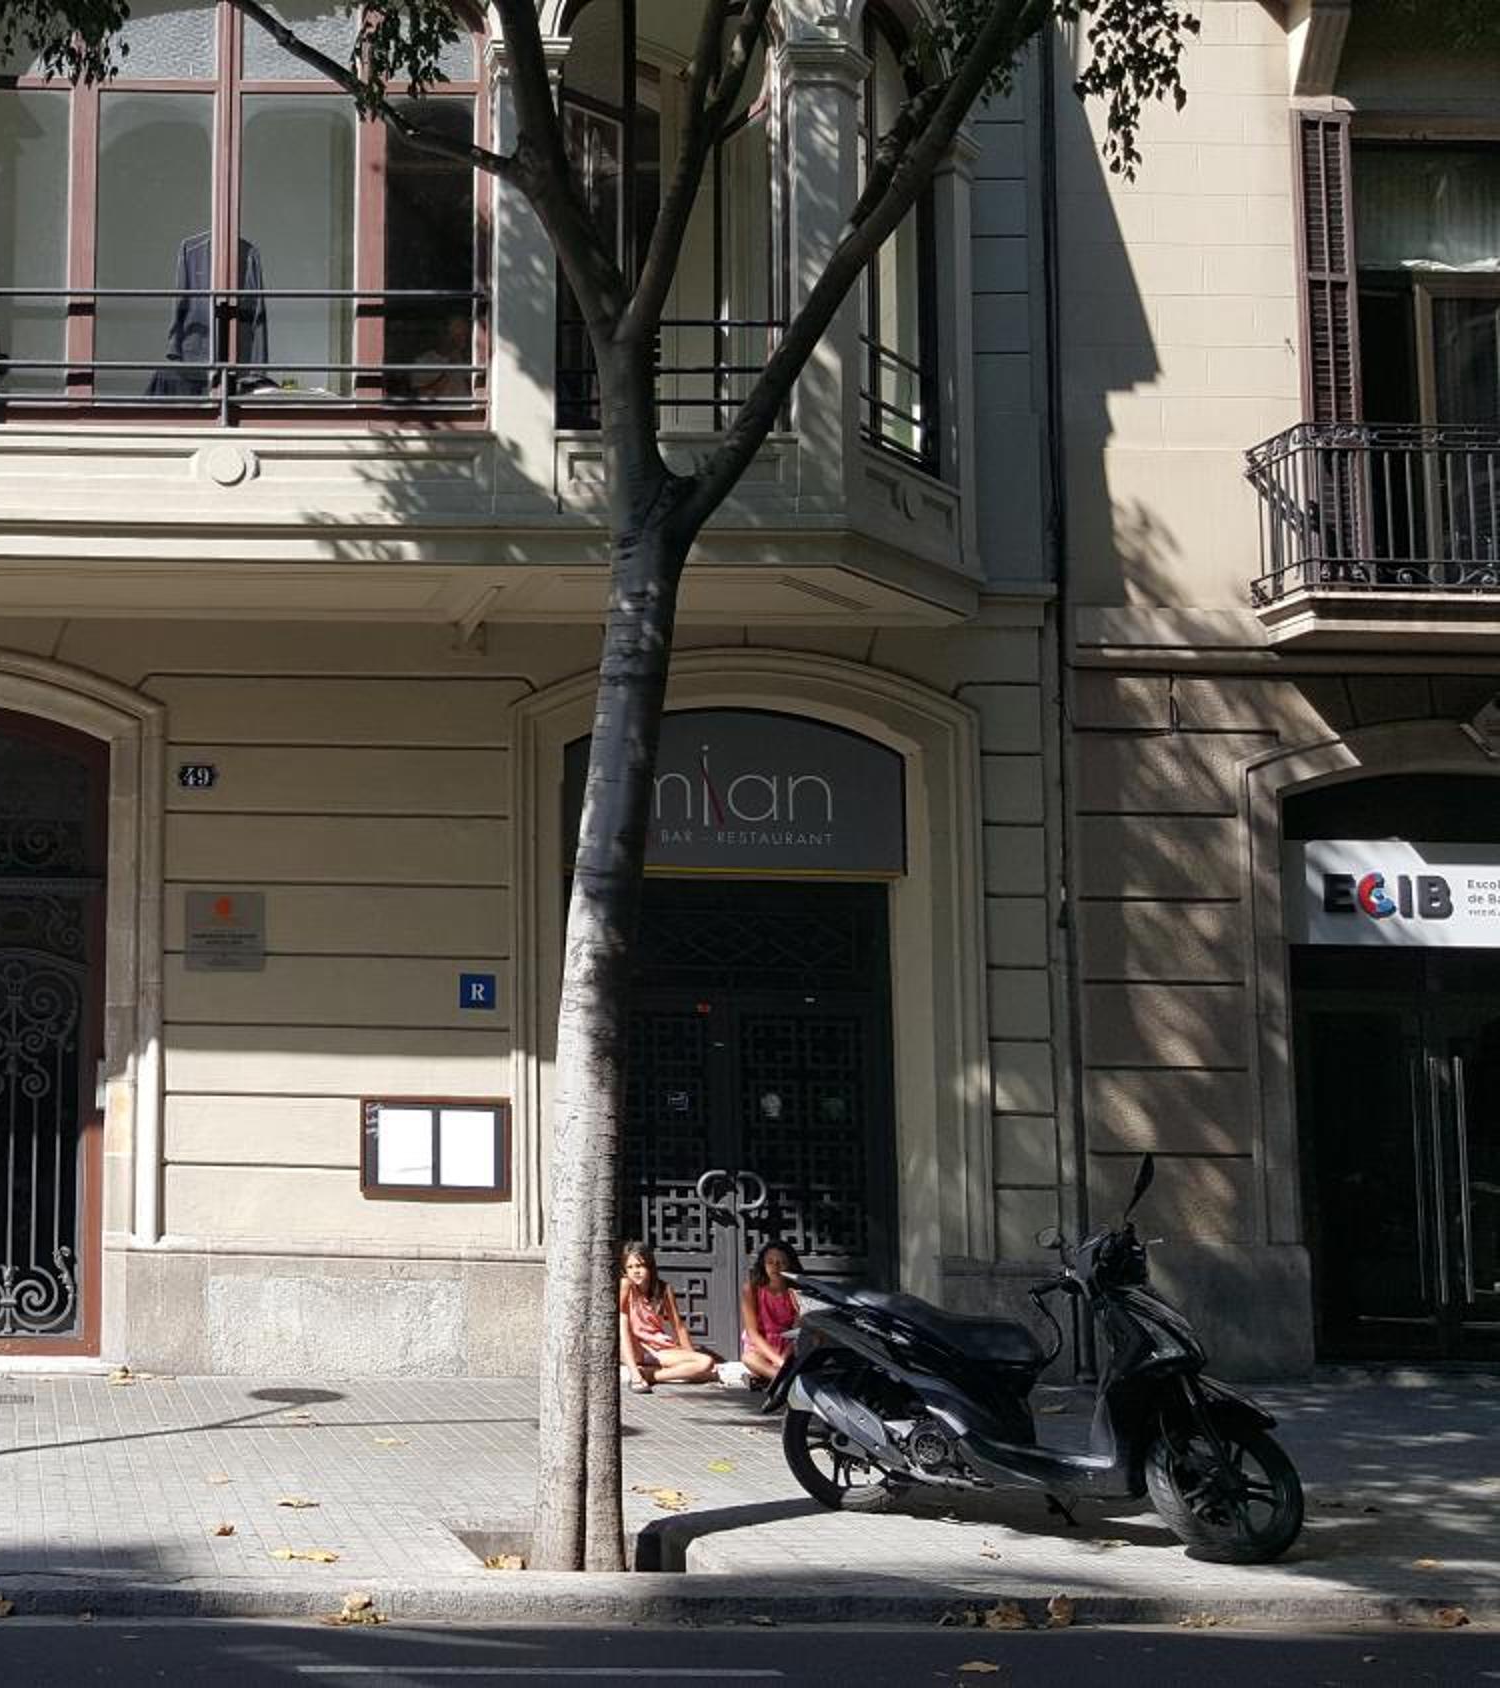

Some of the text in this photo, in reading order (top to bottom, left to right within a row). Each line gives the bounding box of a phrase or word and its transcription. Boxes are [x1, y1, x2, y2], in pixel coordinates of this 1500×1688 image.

[183, 767, 210, 785] 49
[660, 829, 693, 844] BAR
[717, 831, 833, 846] RESTAURANT
[1323, 872, 1455, 920] ECIB
[470, 983, 485, 1001] R
